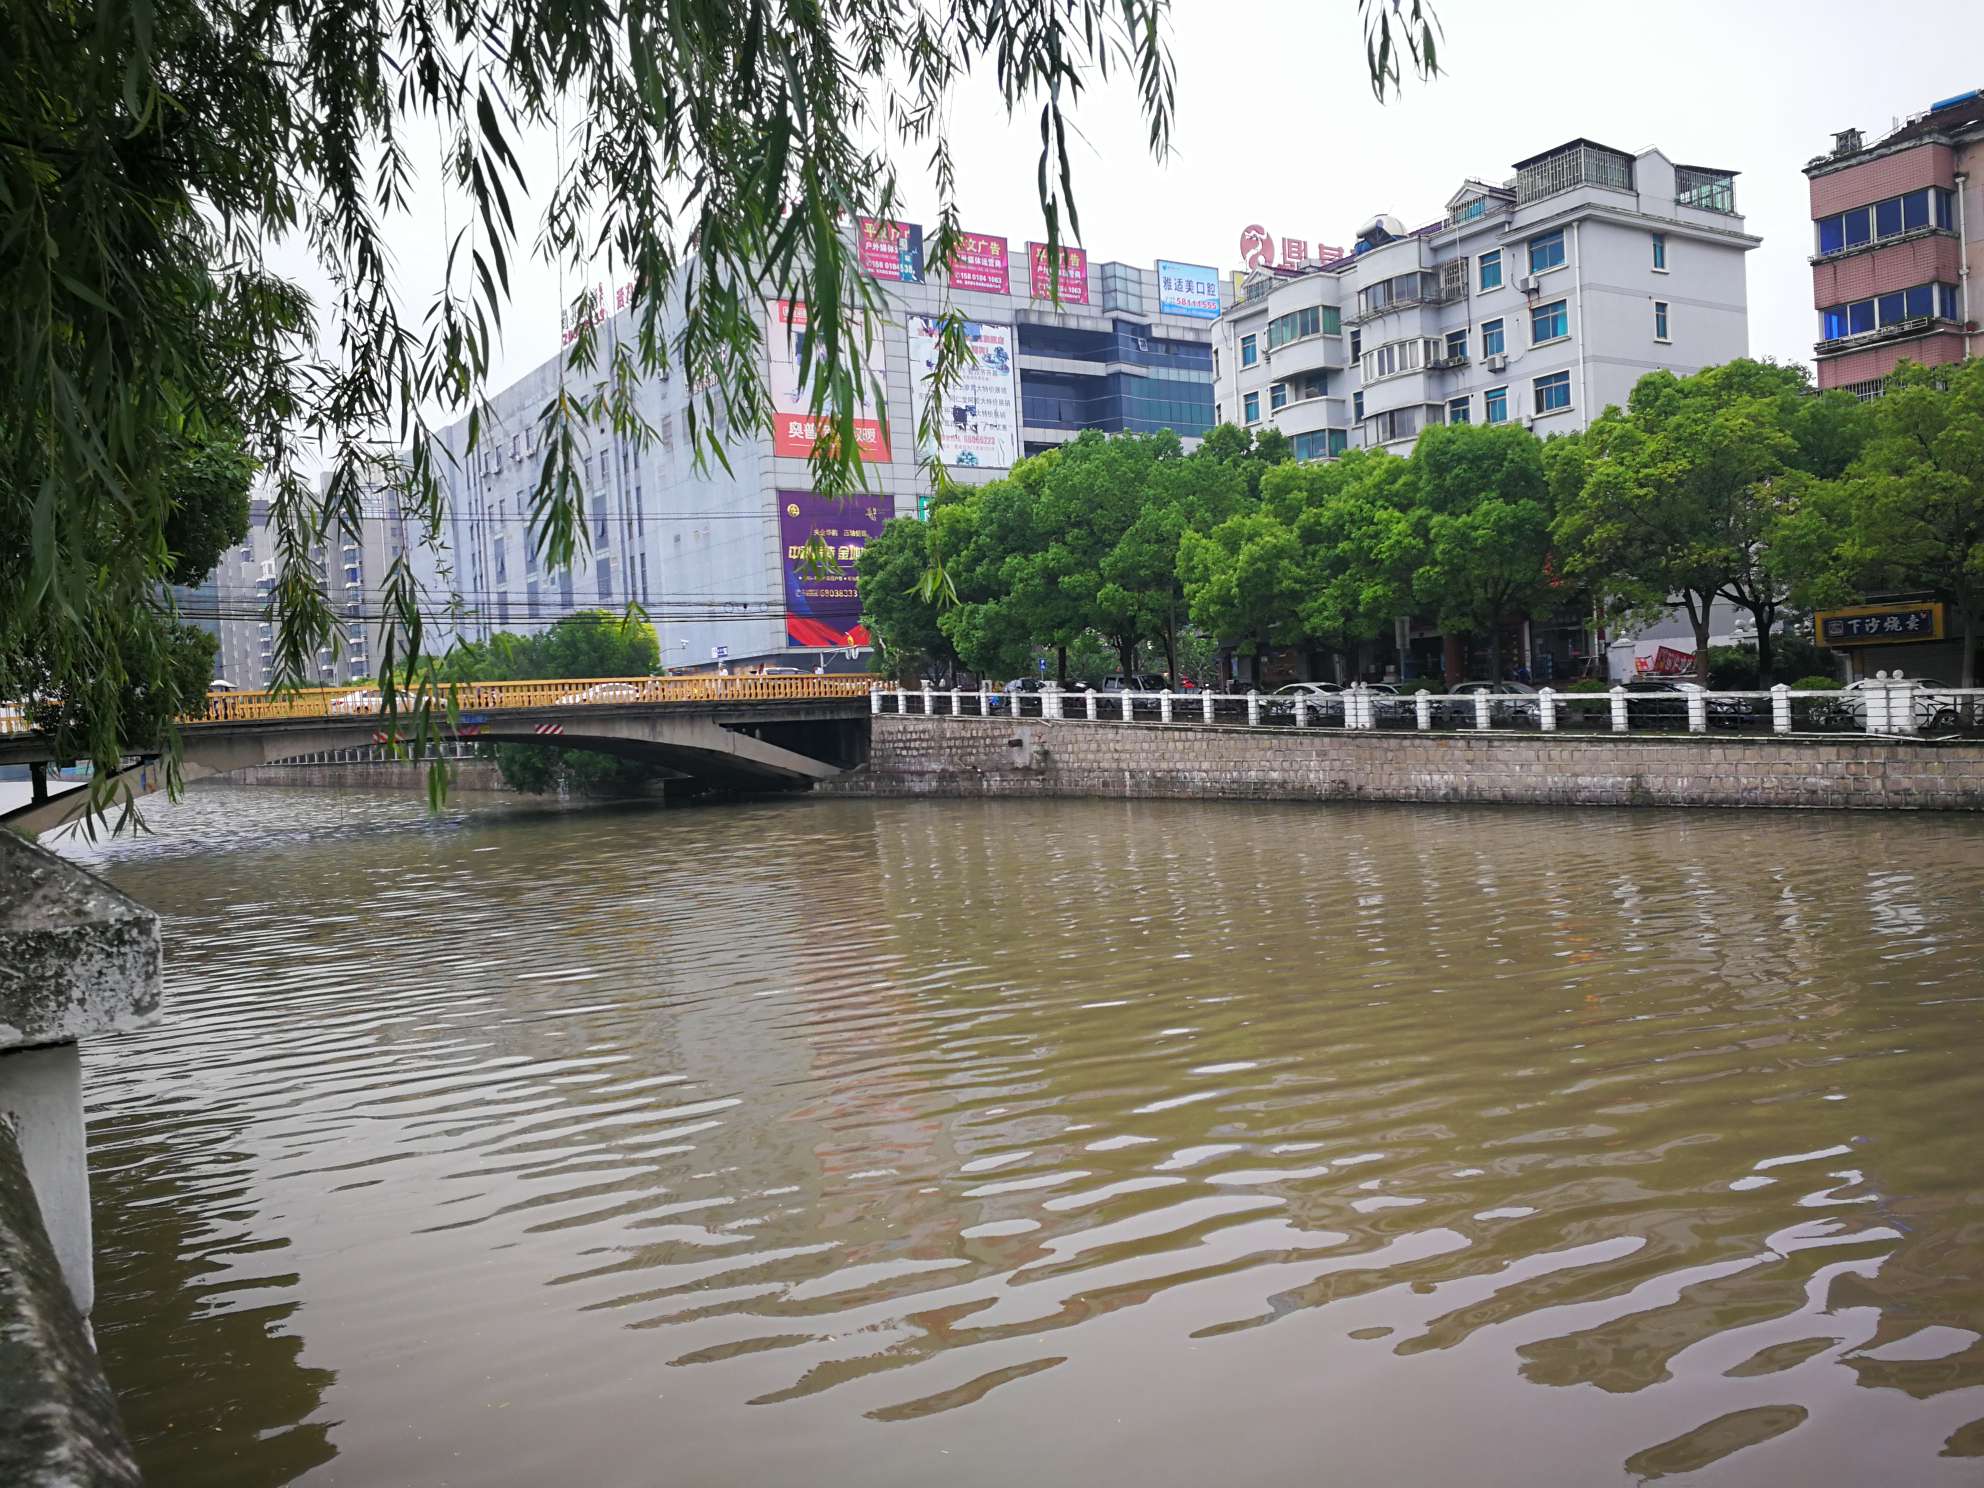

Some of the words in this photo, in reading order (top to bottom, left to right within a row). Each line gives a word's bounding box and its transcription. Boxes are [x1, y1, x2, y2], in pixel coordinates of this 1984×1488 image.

[1163, 276, 1217, 297] 雅适美口腔
